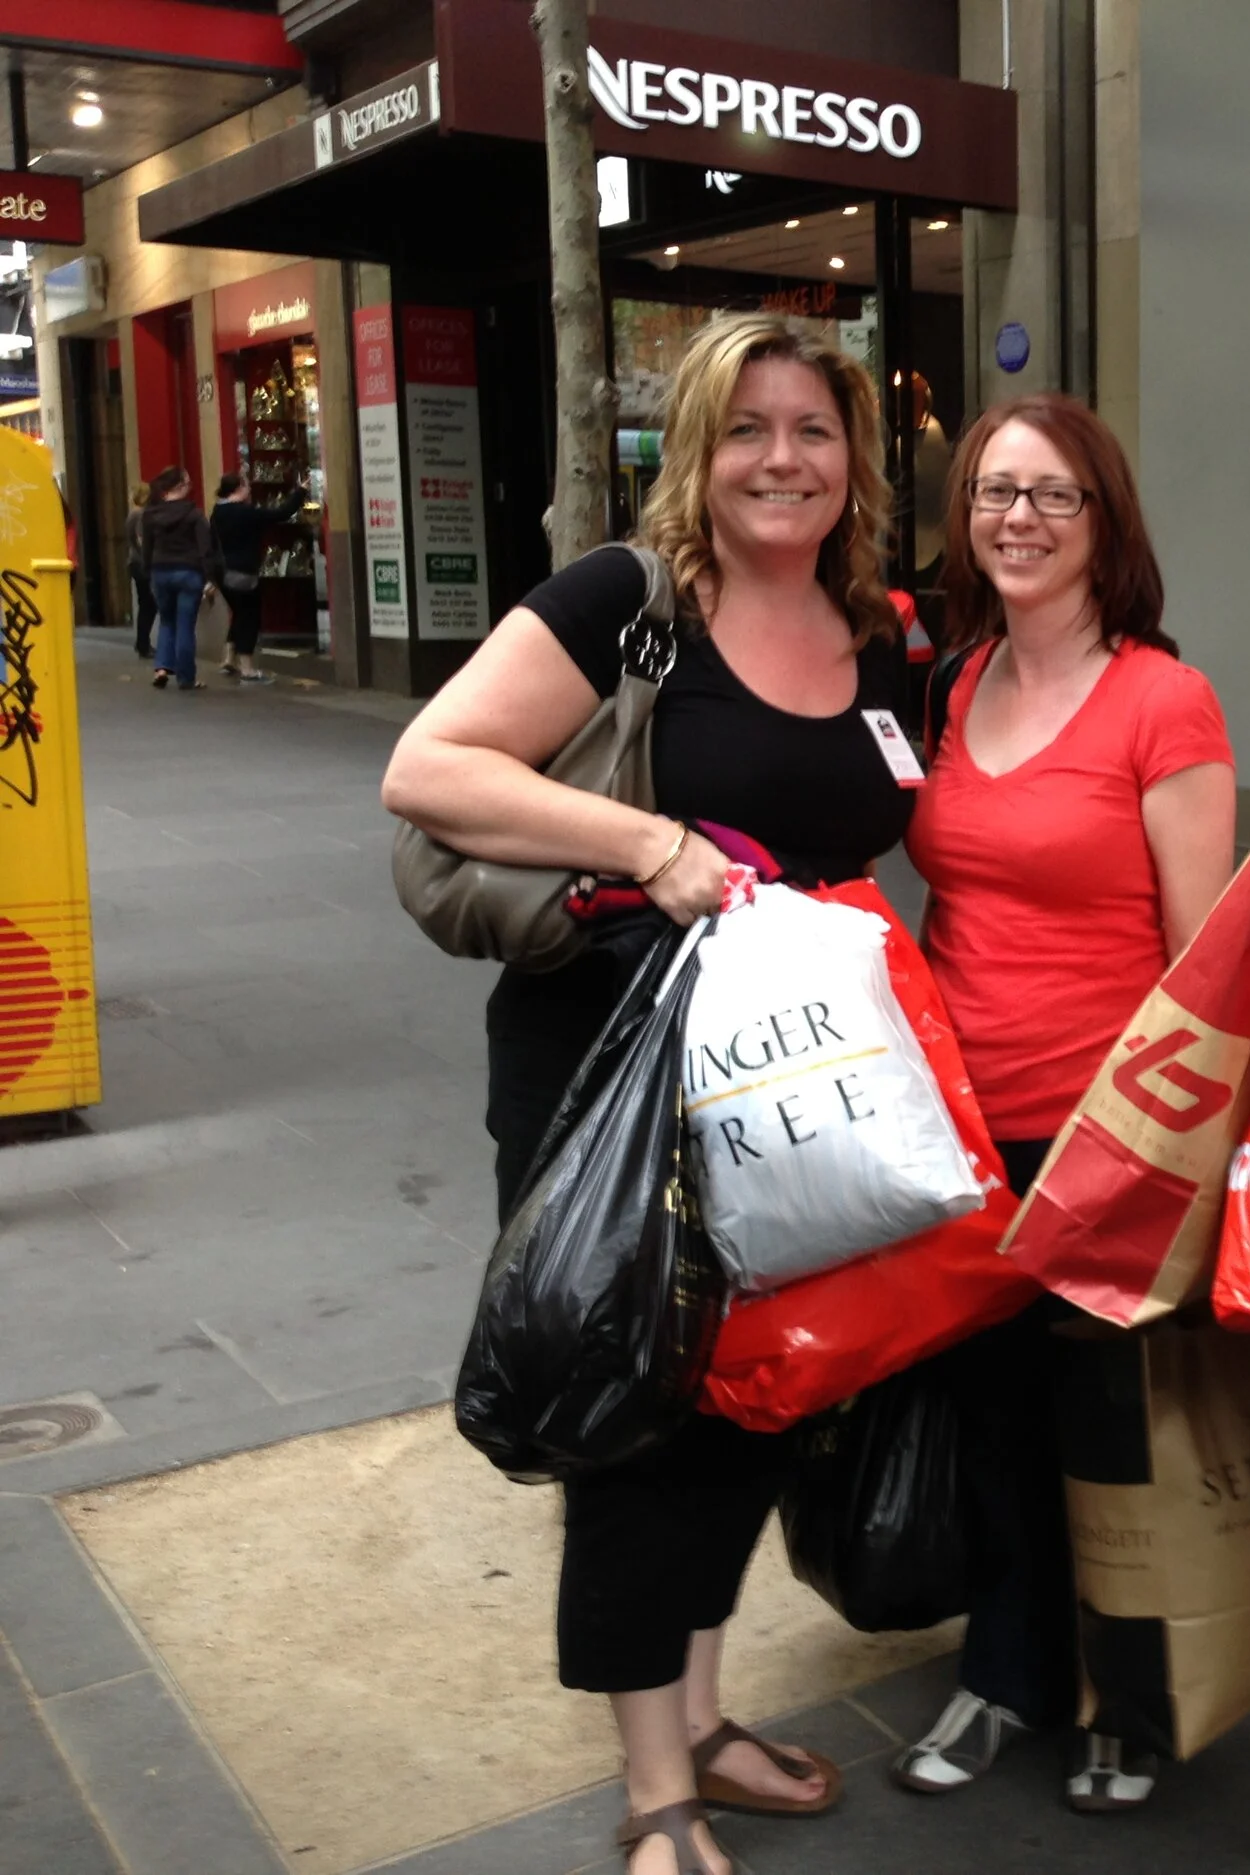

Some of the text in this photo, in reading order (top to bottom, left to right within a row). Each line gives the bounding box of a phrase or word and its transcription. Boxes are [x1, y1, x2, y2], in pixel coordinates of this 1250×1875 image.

[338, 84, 418, 151] NESPRESSO
[586, 45, 921, 158] NESPRESSO
[0, 192, 47, 222] ate
[688, 1001, 847, 1095] INGER
